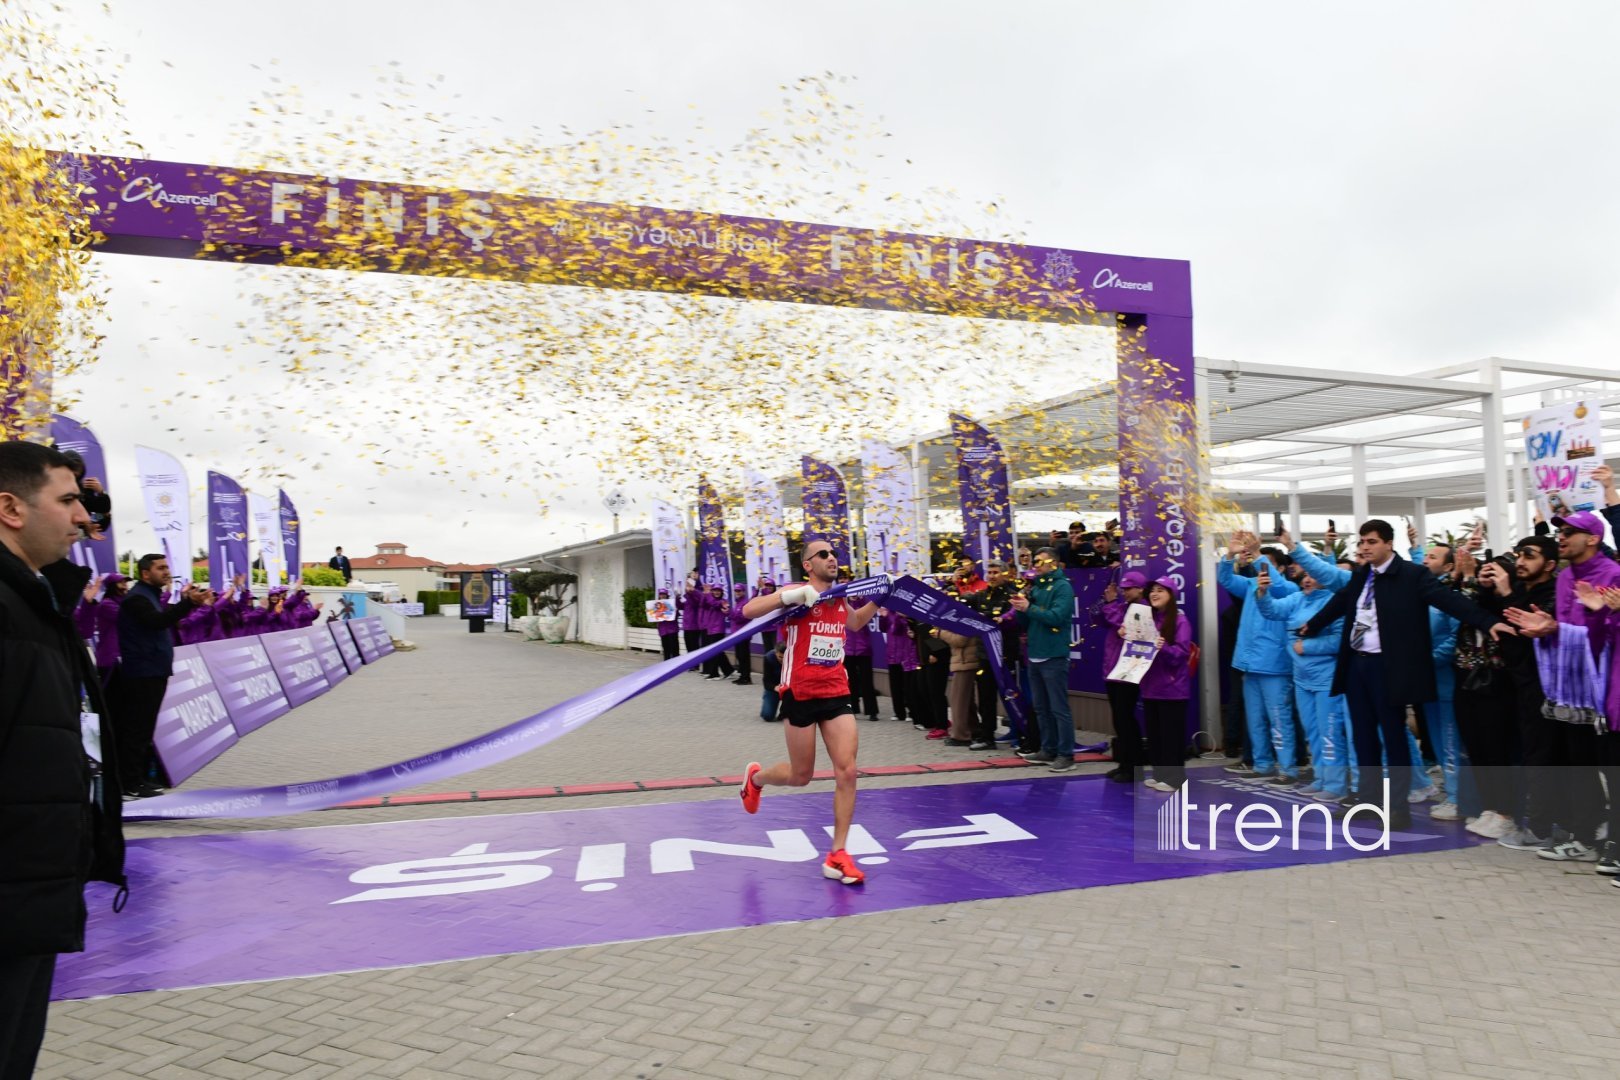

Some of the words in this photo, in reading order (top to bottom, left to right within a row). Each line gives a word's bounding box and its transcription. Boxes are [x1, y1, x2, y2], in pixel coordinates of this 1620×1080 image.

[156, 190, 217, 206] Azercell
[1115, 278, 1153, 291] Azercell
[808, 620, 846, 634] TÜRKİY
[811, 646, 840, 658] 20807
